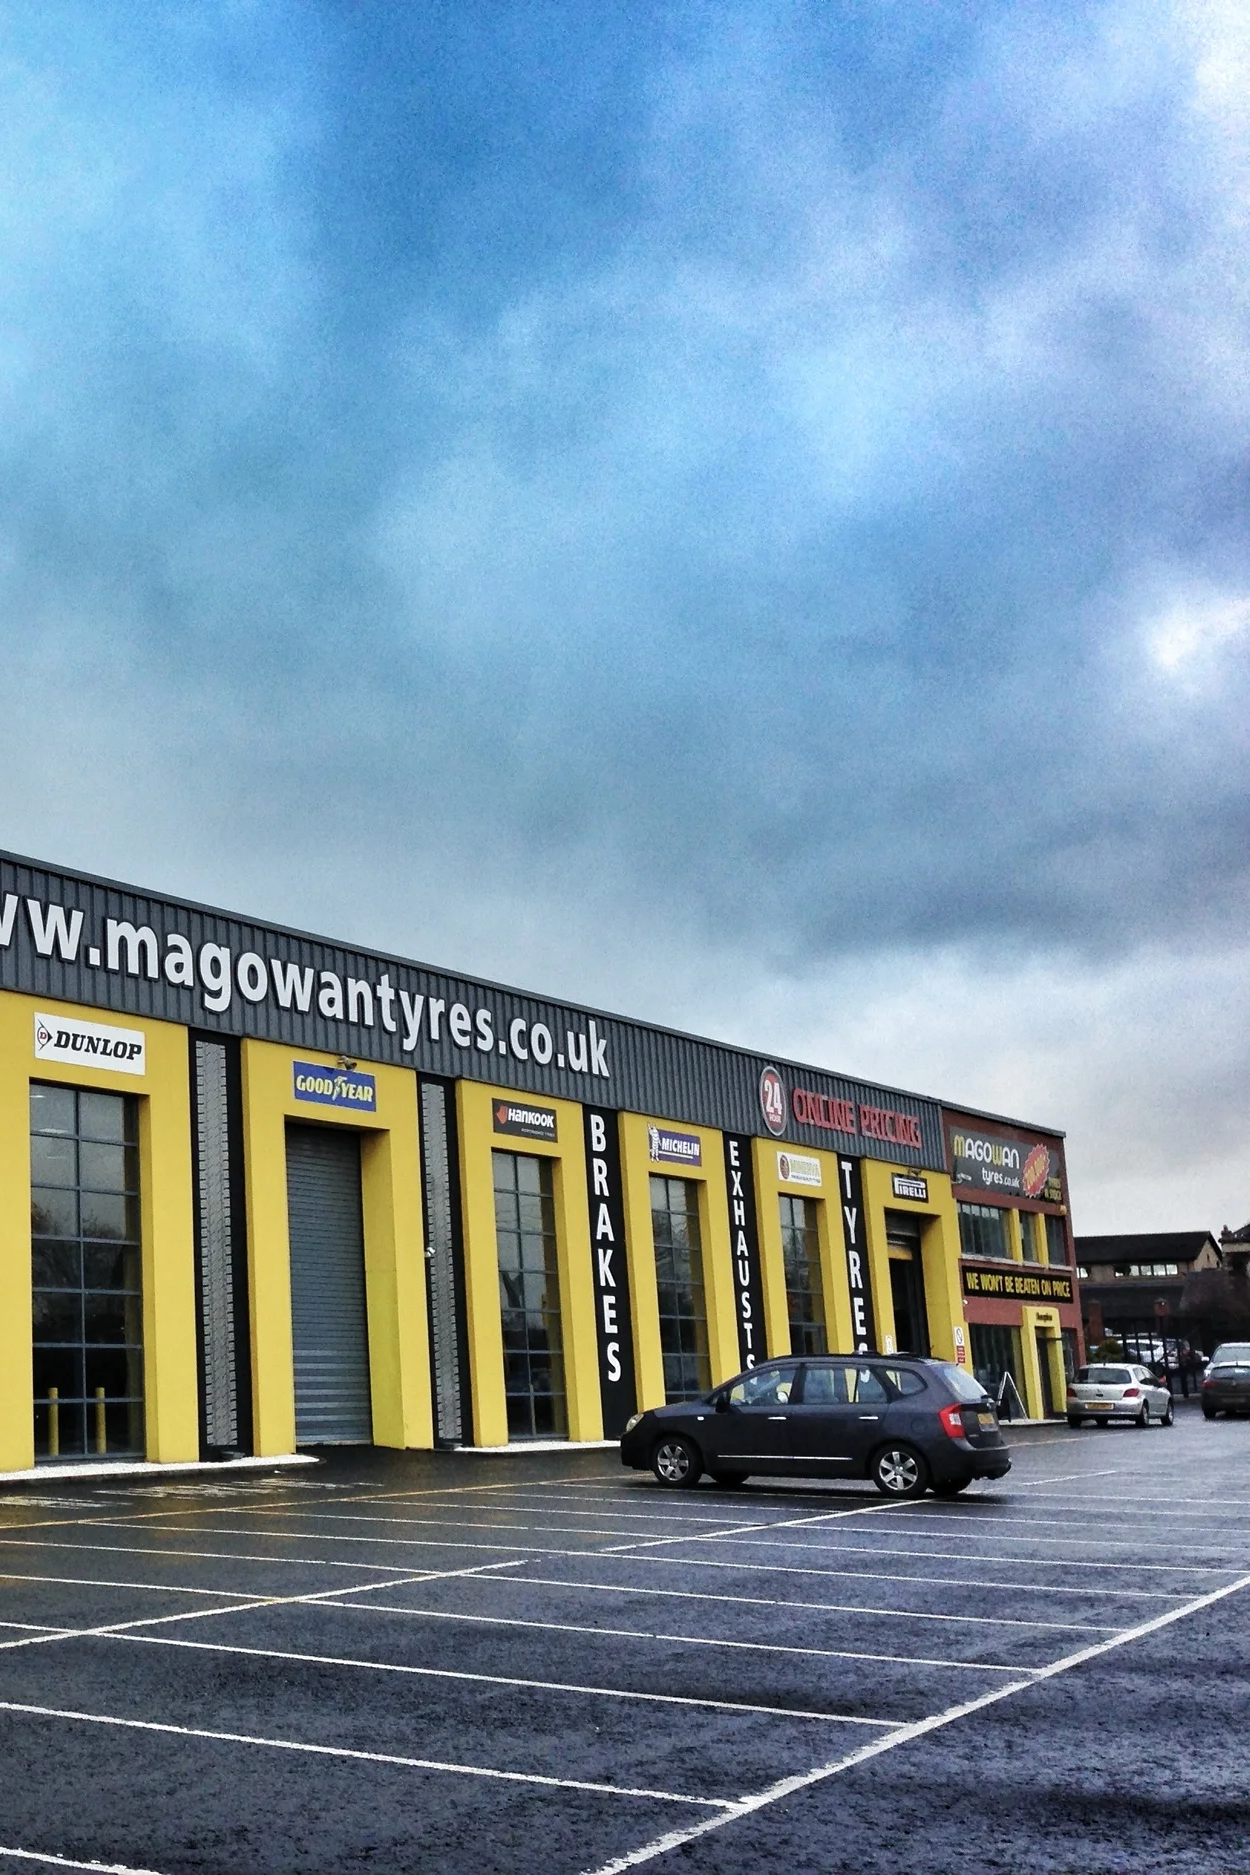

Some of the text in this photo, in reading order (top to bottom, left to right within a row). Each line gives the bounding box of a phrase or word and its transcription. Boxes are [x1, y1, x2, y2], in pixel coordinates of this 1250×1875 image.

[53, 1030, 142, 1060] DUNLOP
[764, 1079, 782, 1115] 24
[792, 1088, 922, 1149] ONLINE PRICING
[662, 1137, 700, 1156] MICHELIN
[953, 1134, 1020, 1169] MAGOWAN
[894, 1177, 926, 1199] PIRELLI
[590, 1114, 621, 1382] BRAKES
[841, 1161, 868, 1354] TYRE
[966, 1272, 979, 1290] WE
[1004, 1276, 1014, 1293] BE
[1015, 1276, 1040, 1295] BEATEN
[1041, 1279, 1051, 1296] ON
[1052, 1280, 1070, 1297] PRICE
